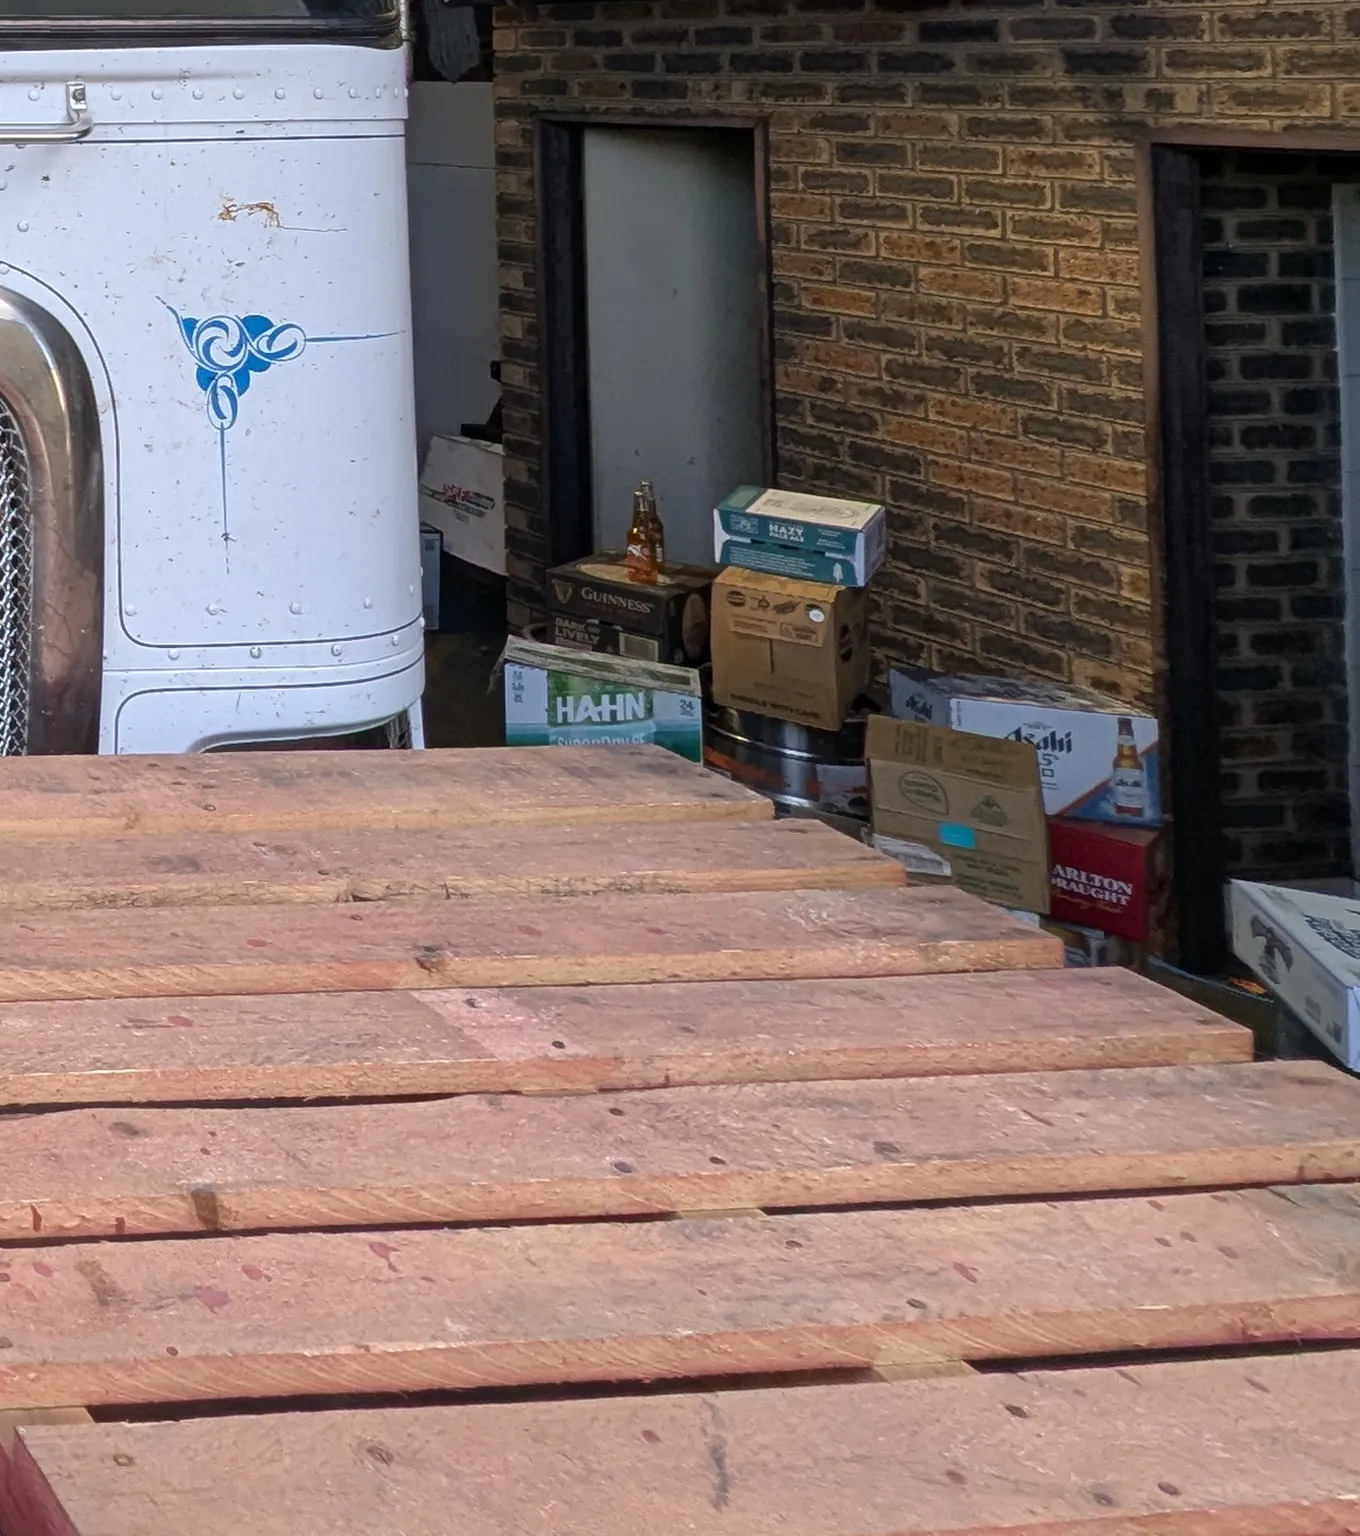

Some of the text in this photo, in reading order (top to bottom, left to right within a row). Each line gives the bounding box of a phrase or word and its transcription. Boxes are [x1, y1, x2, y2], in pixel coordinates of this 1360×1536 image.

[768, 523, 805, 537] HAZY
[581, 586, 652, 614] GUINNESS
[555, 616, 586, 632] DARK
[555, 626, 601, 646] LIVELY
[555, 692, 695, 724] HAHN 24
[1003, 726, 1073, 754] Asahi
[1052, 864, 1134, 896] ARLTON
